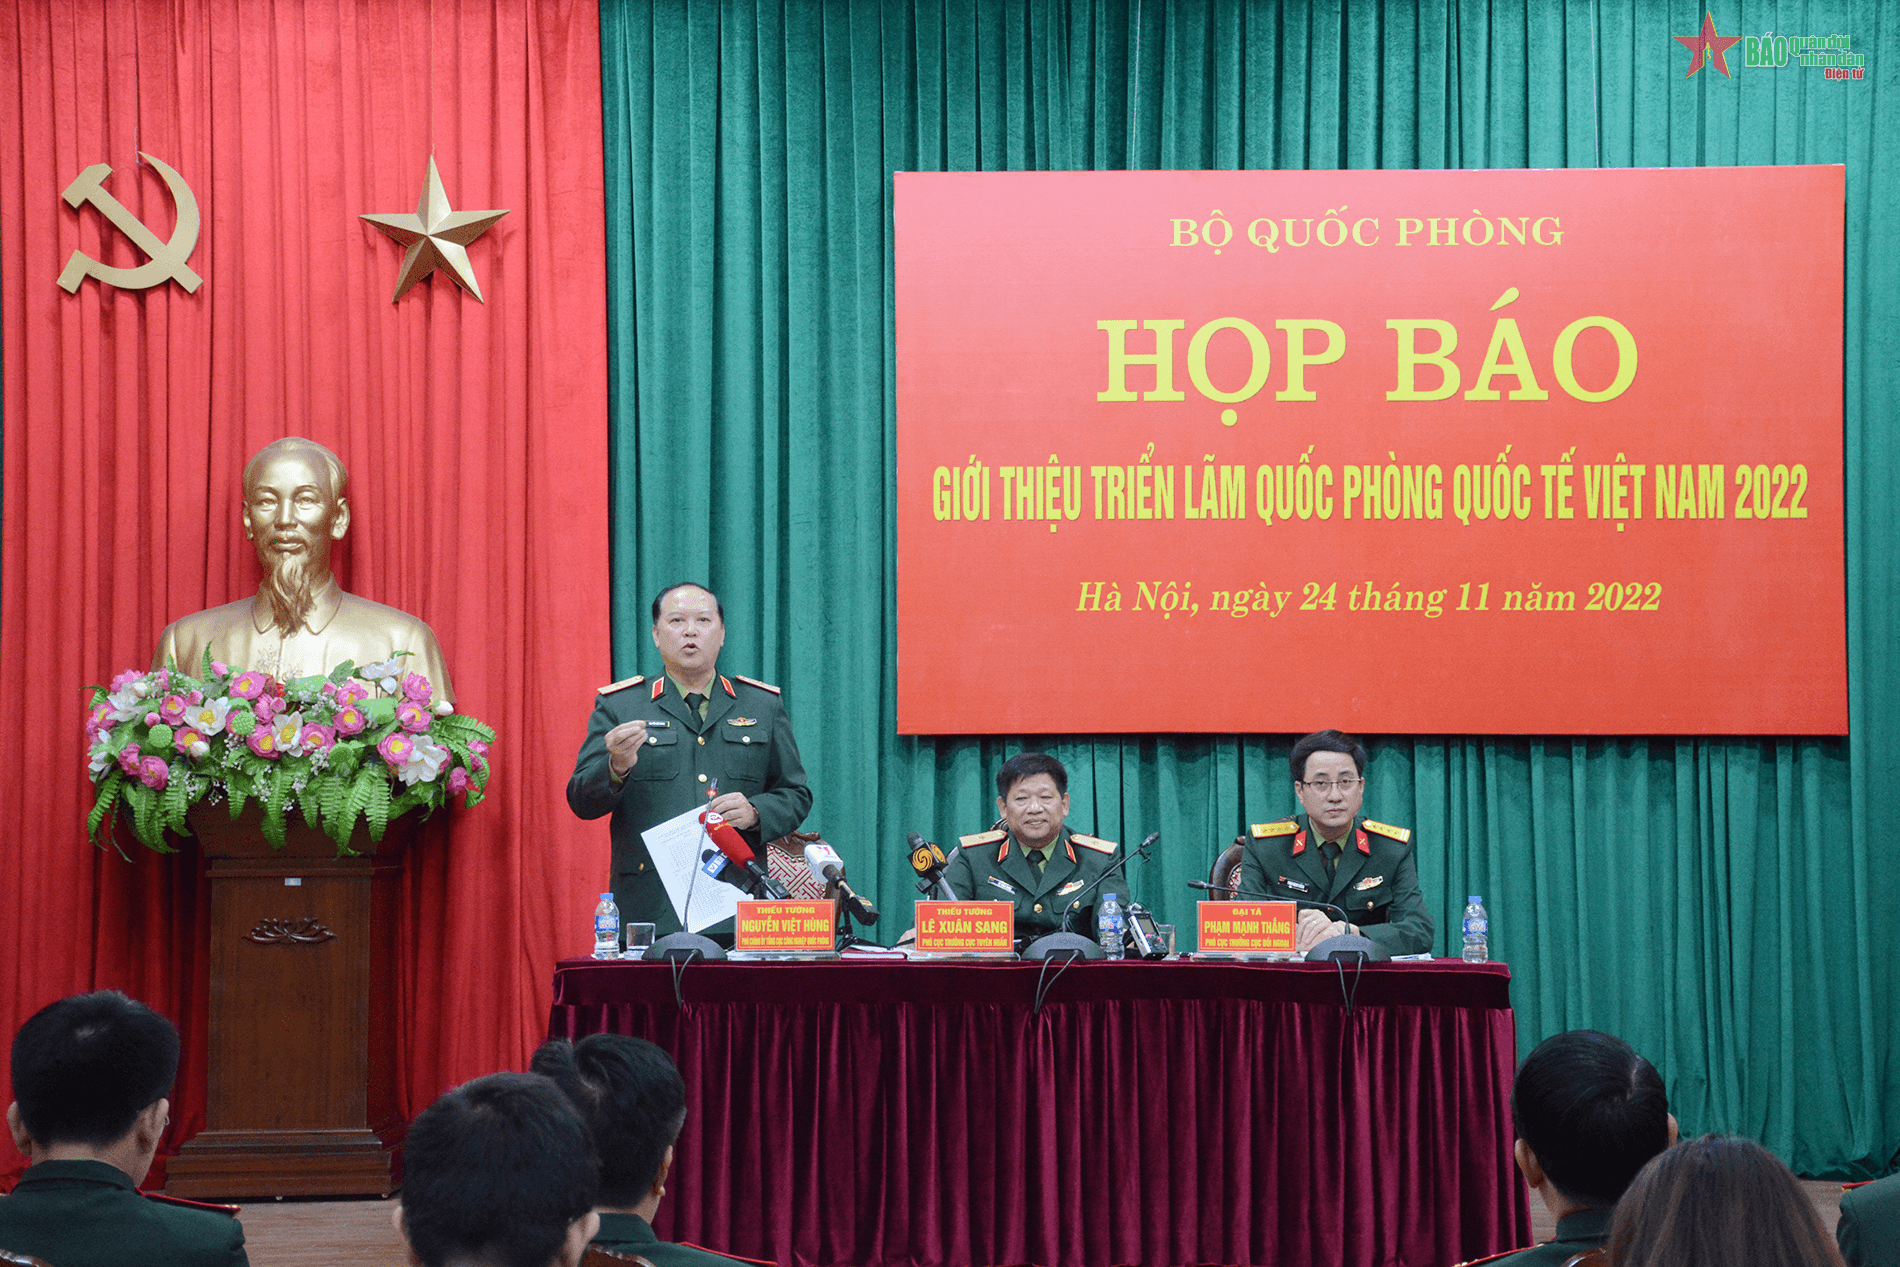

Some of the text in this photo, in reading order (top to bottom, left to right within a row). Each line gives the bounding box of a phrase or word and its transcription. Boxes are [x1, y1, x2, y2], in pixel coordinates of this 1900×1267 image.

[1170, 205, 1566, 255] BỘ QUỐC PHÒNG
[1097, 287, 1639, 427] HỌP BÁO
[933, 442, 1808, 533] GIỚI THIỆU TRIỂN LÃM QUỐC PHÒNG QUỐC TẾ VIỆT NAM 2022
[1075, 581, 1662, 620] Hà Nội, ngày 24 tháng 11 năm 2022
[756, 905, 815, 914] THIẾU TƯỚNG
[937, 907, 993, 915] THIẾU TƯỚNG
[1232, 908, 1248, 916] ĐẠI
[742, 916, 829, 934] NGUYỄN VIỆT HÙNG
[922, 918, 1008, 933] LÊ XUÂN SANG
[1204, 917, 1290, 936] PHẠM MẠNH THẮNG
